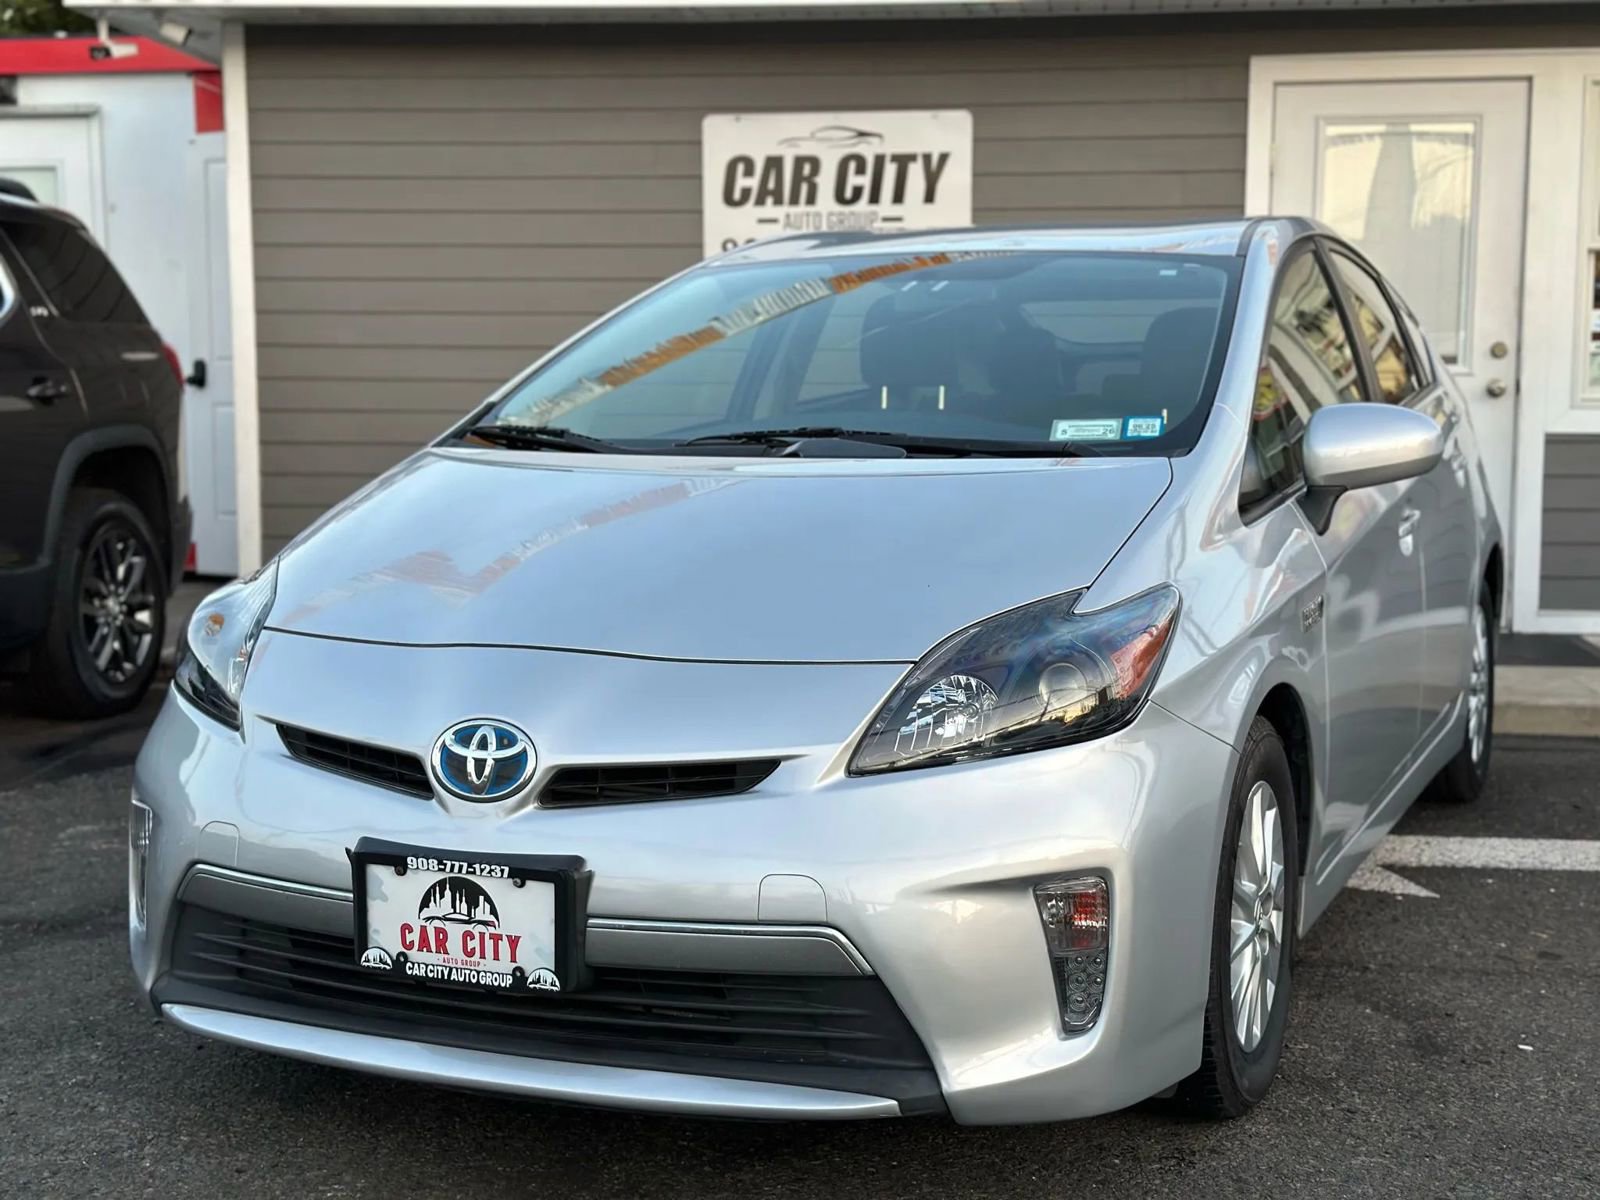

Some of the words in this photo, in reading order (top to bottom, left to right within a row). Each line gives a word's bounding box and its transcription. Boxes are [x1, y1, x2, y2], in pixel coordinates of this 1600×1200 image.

[722, 155, 821, 207] CAR
[832, 152, 951, 206] CITY
[784, 212, 822, 231] AUTO
[407, 857, 509, 878] 908-777-1237
[400, 923, 449, 954] CAR
[462, 930, 521, 963] CITY
[443, 957, 458, 966] AUTO
[405, 962, 426, 975] CAR
[426, 965, 449, 980] CITY
[450, 968, 478, 984] AUTO
[478, 971, 513, 988] GROUP
